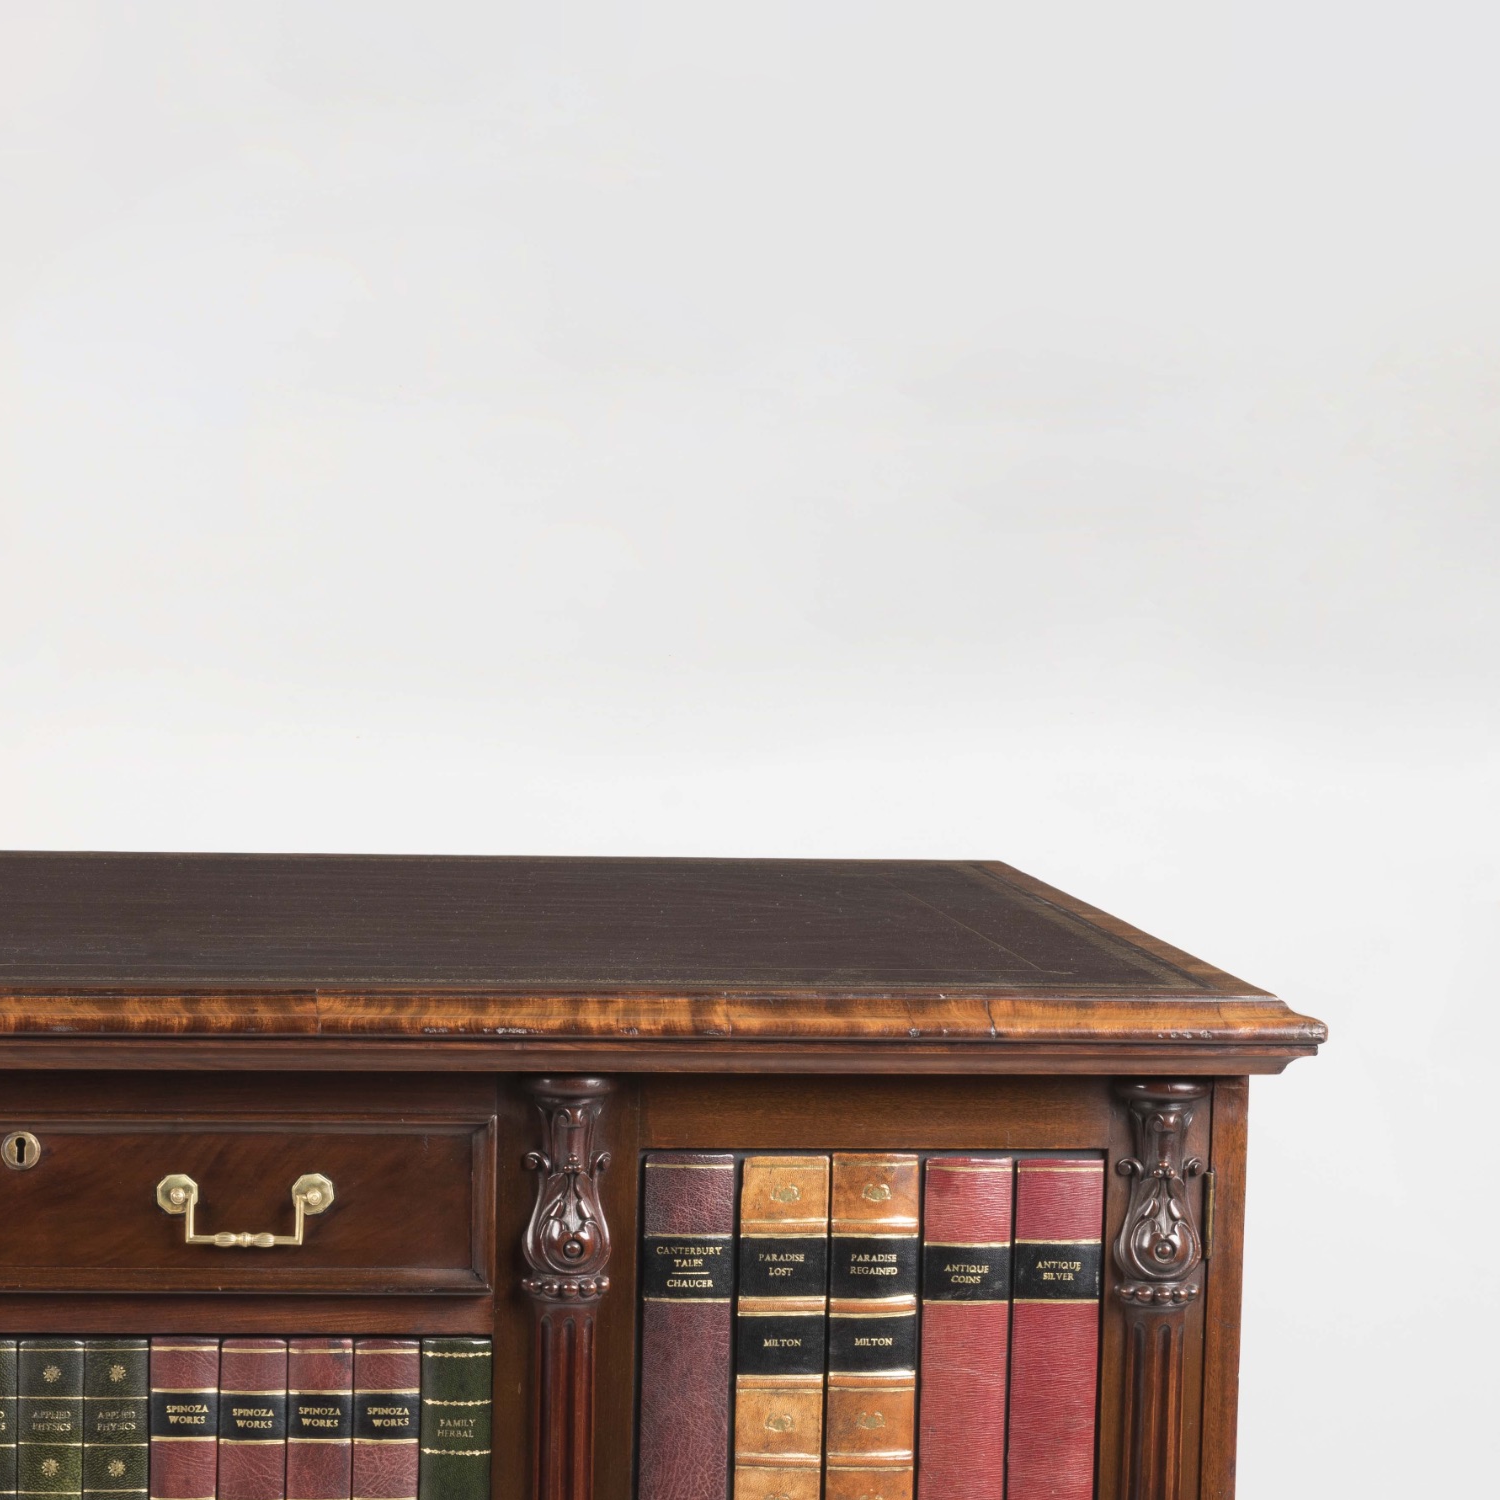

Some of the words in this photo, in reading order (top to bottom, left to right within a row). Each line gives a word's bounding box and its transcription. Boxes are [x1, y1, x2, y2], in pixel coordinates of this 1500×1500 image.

[656, 1246, 722, 1255] CANTERBURY
[759, 1254, 805, 1262] PARADISE
[851, 1254, 897, 1262] PARADISE
[674, 1259, 703, 1267] TALES
[1036, 1261, 1081, 1271] ANTIQUE
[769, 1267, 793, 1276] LOST
[850, 1266, 898, 1275] REGAINED
[944, 1264, 989, 1274] ANTIQUE
[667, 1279, 713, 1288] CHAUCER
[951, 1275, 981, 1284] COINS
[763, 1339, 801, 1347] MILTON
[854, 1338, 892, 1346] MILTON
[166, 1405, 209, 1414] SPINOZA
[232, 1408, 274, 1417] SPINOZA
[299, 1406, 341, 1416] SPINOZA
[367, 1407, 409, 1416] SPINOZA
[33, 1411, 71, 1419] APPLIED
[168, 1415, 206, 1425] WORKS
[236, 1419, 273, 1429] WORKS
[301, 1417, 339, 1427] WORKS
[372, 1417, 409, 1427] WORKS
[440, 1419, 476, 1428] FAMILY
[33, 1422, 71, 1431] PHYSICS
[437, 1428, 474, 1438] HERBAL
